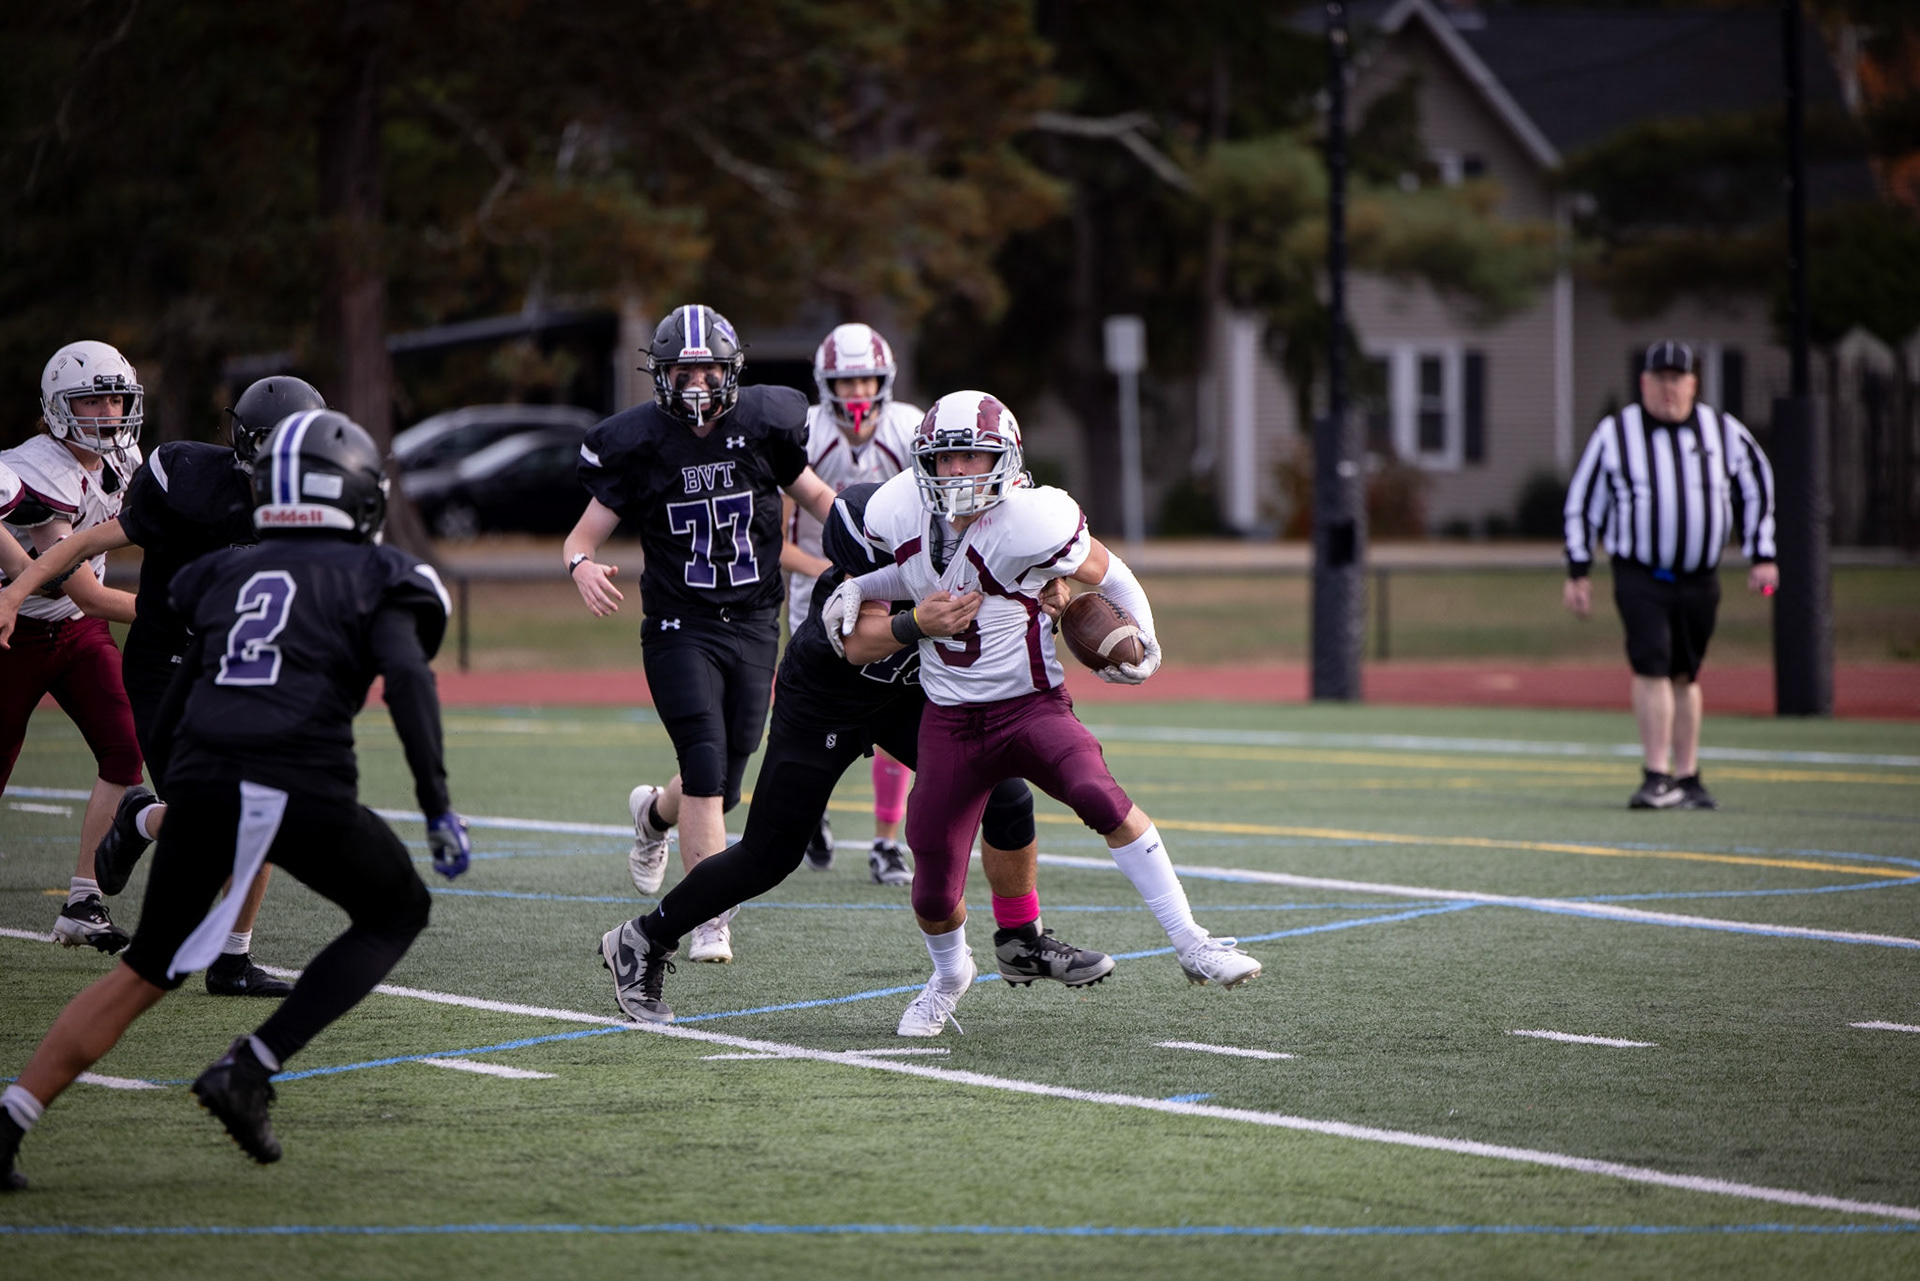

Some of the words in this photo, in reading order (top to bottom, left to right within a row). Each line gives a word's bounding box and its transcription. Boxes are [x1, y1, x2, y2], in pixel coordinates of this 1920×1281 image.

[682, 461, 735, 493] BVT
[262, 509, 323, 524] Riddell
[667, 490, 759, 588] 77
[214, 570, 297, 686] 2
